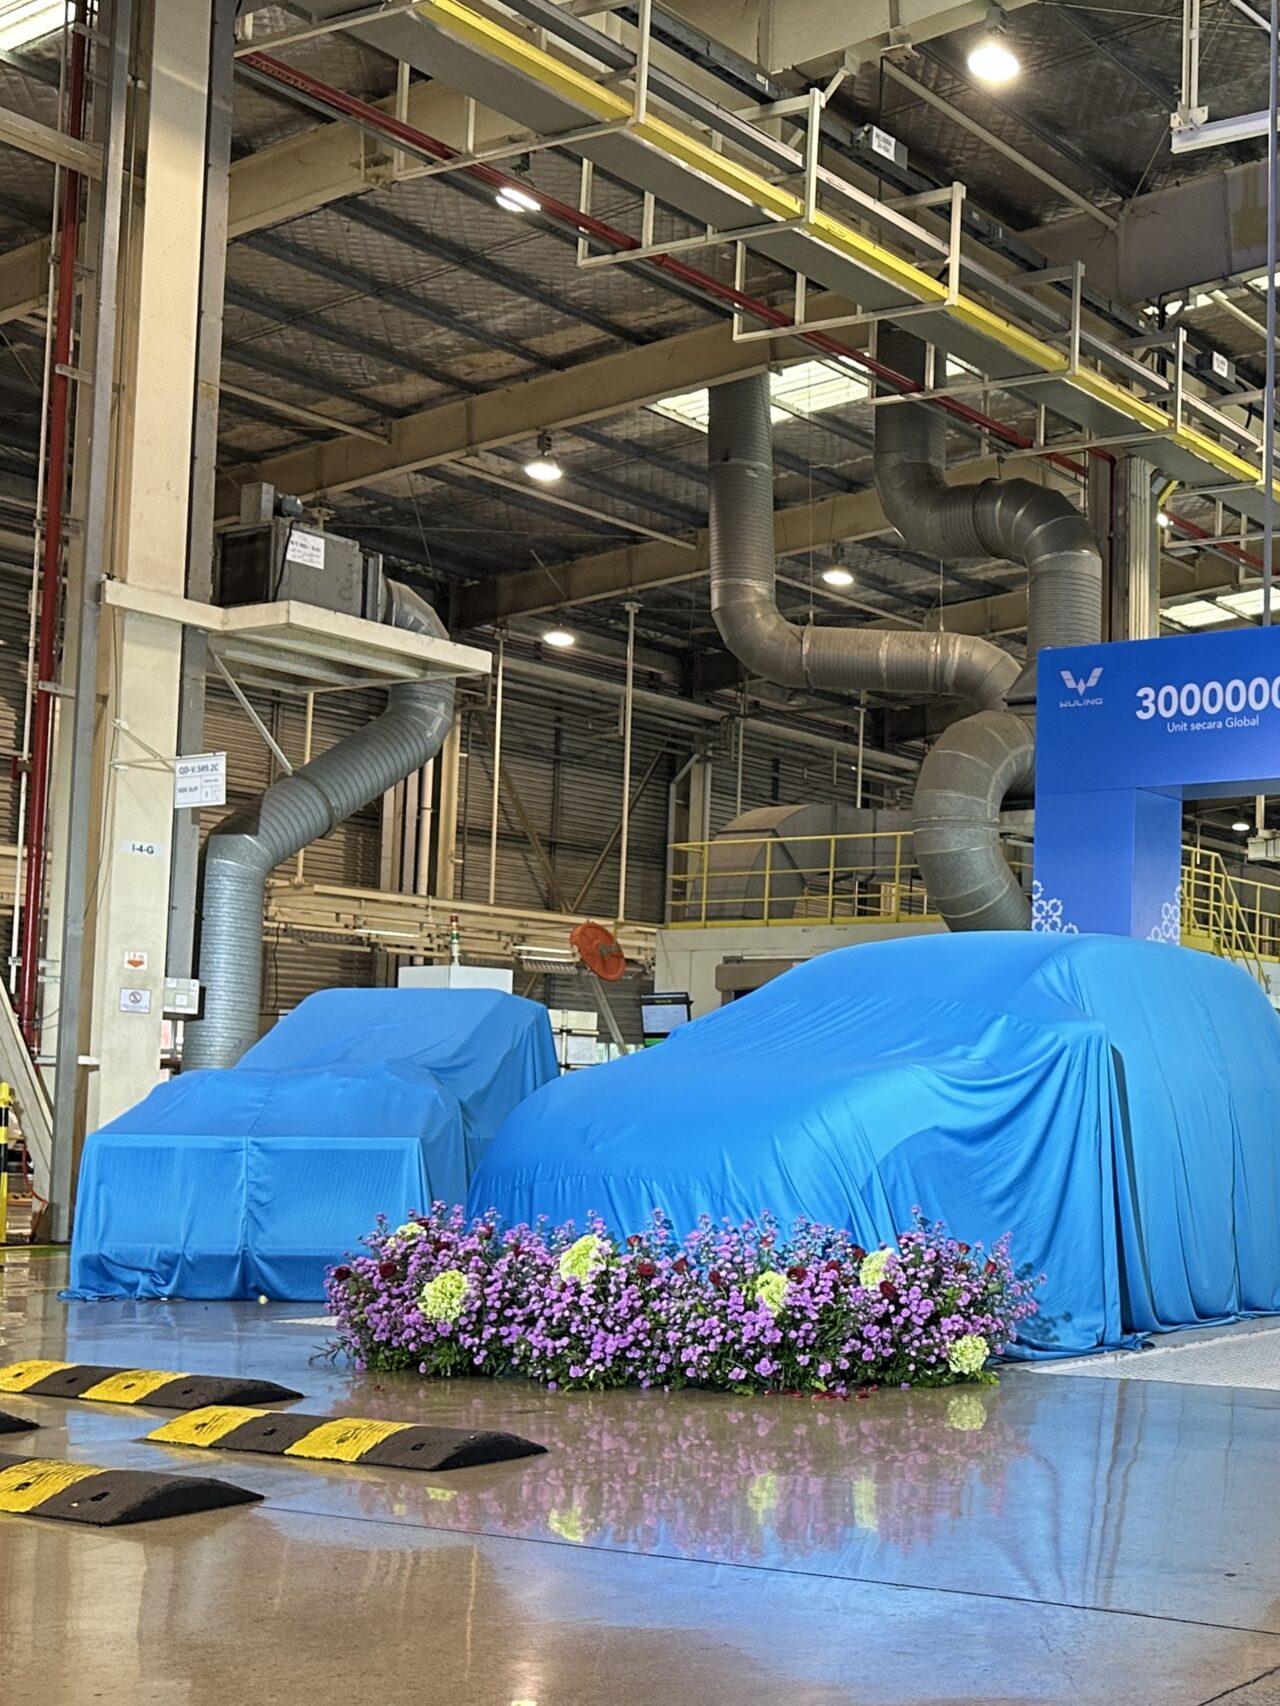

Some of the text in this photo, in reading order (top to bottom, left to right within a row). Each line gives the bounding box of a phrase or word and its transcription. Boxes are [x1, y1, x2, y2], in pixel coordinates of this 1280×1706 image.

[1059, 697, 1104, 709] WULING
[1167, 715, 1260, 733] Unit secara Global
